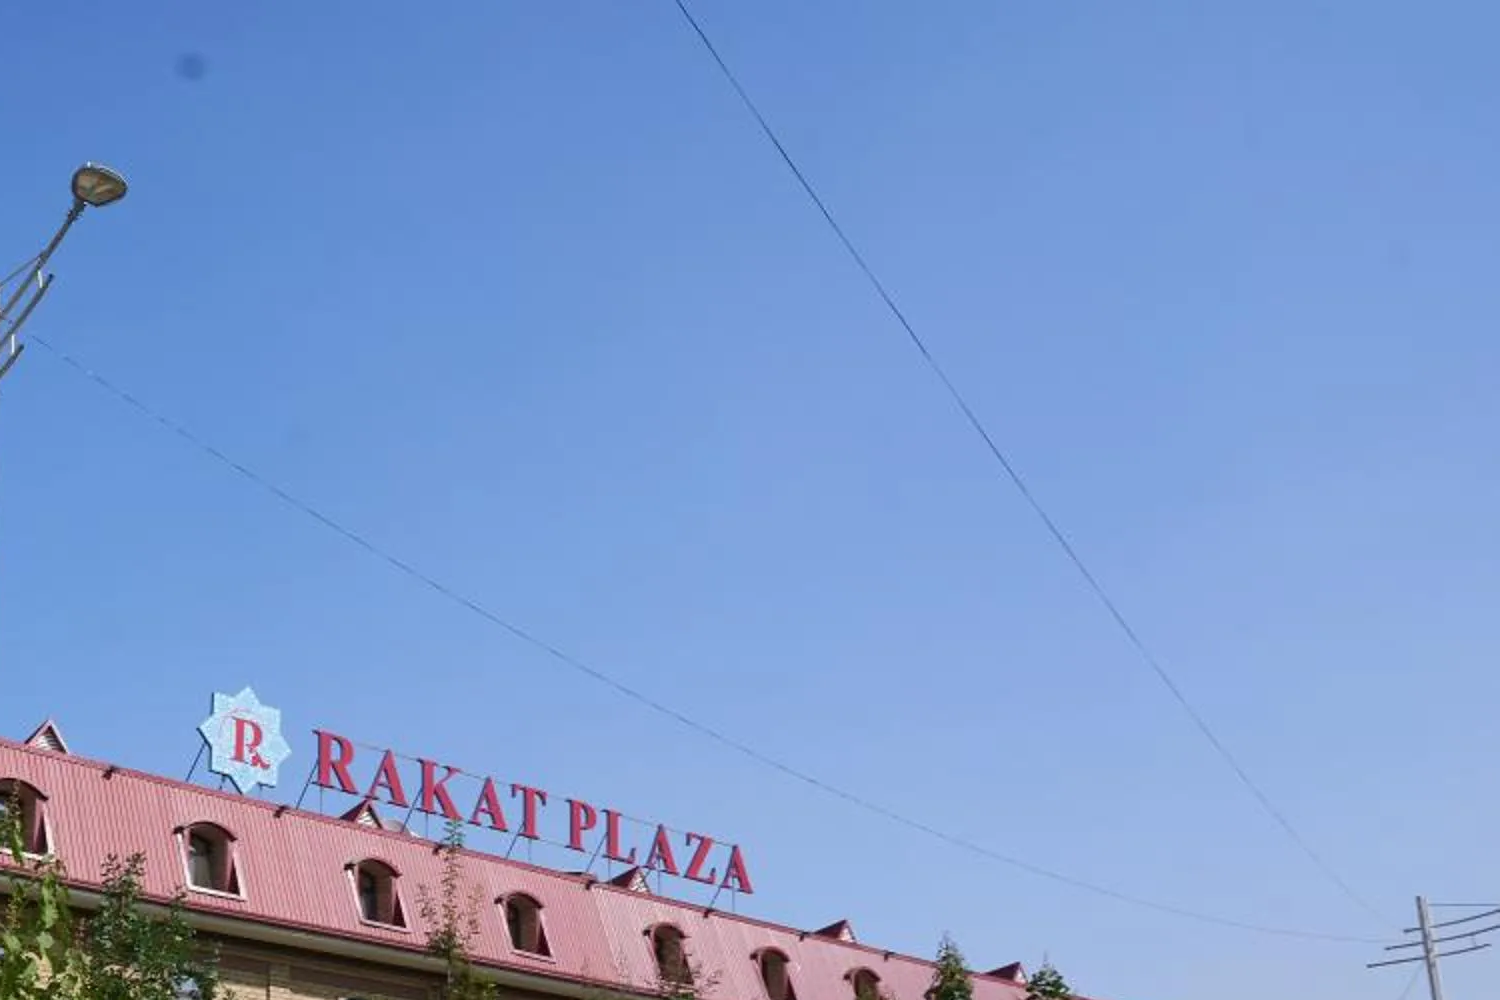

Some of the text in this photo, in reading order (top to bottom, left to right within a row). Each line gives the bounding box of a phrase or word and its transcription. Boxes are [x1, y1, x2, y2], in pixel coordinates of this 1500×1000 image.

[228, 715, 271, 769] R
[311, 729, 754, 894] RAKAT PLAZA
